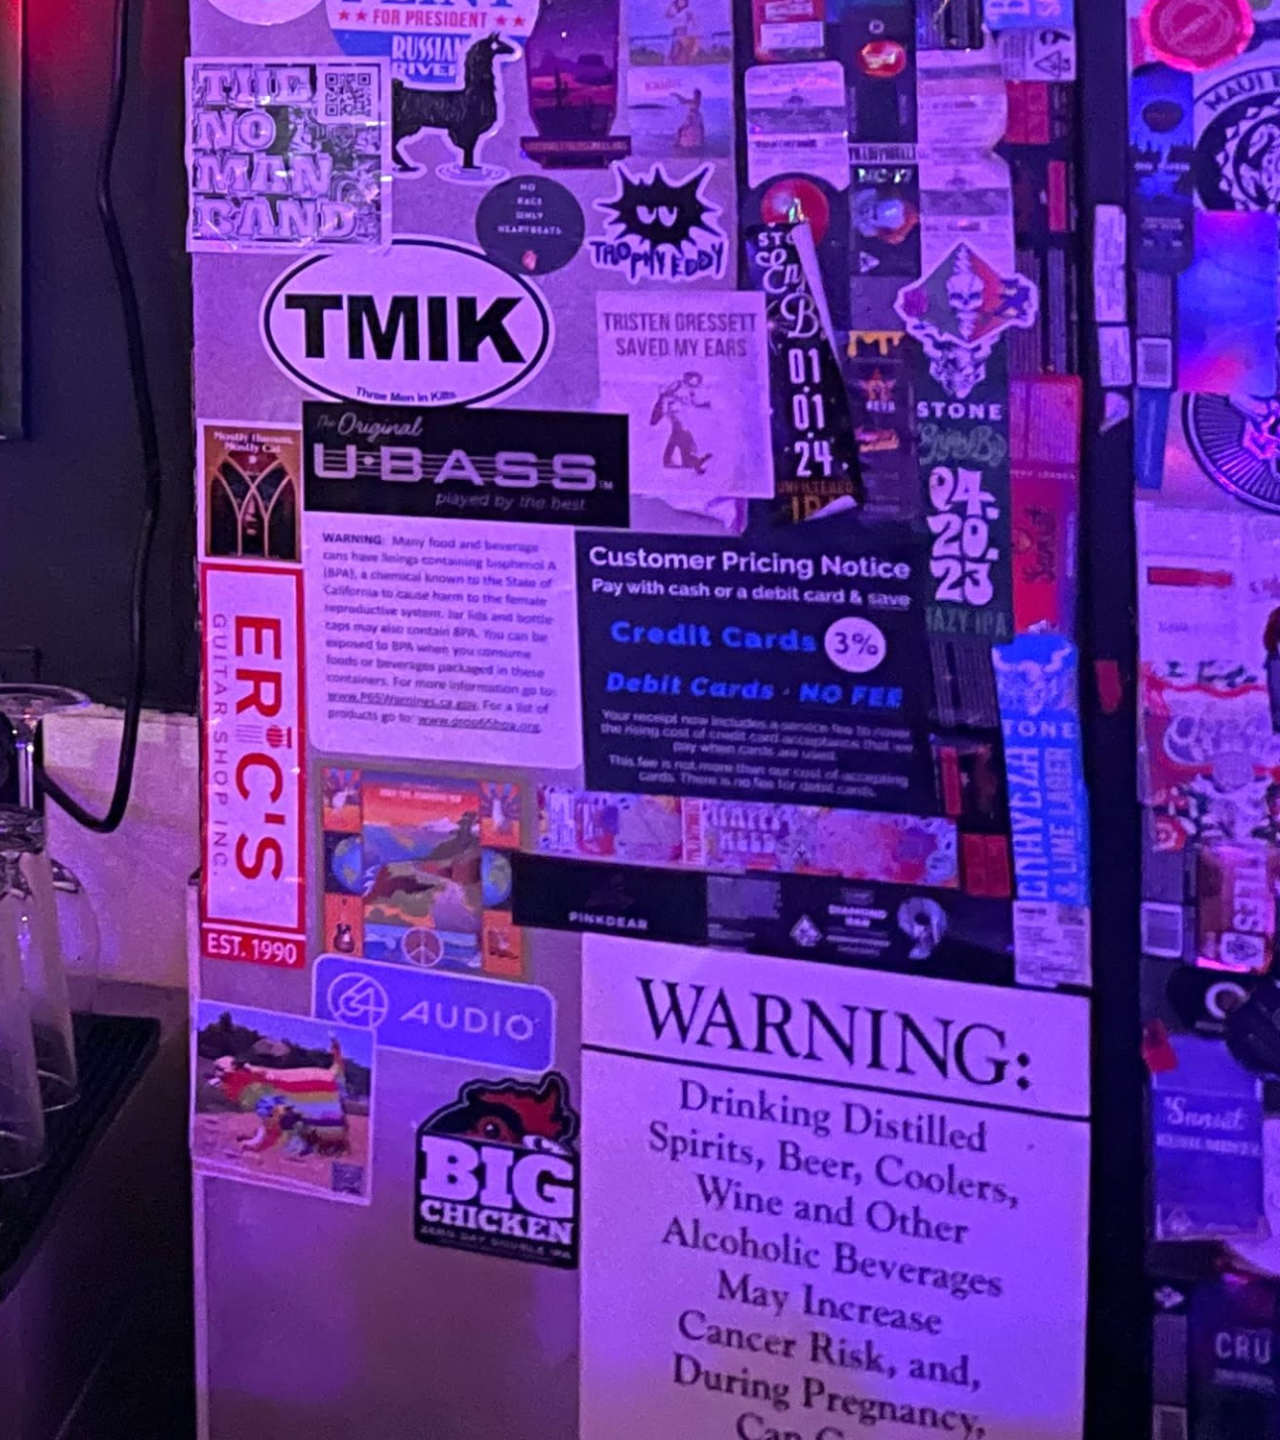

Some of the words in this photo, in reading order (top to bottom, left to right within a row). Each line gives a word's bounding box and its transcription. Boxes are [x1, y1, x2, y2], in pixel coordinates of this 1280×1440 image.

[372, 9, 402, 26] FOR
[405, 9, 487, 29] PRESIDENT
[392, 35, 467, 60] RUSSIAN
[193, 67, 313, 107] THE
[1203, 71, 1268, 111] MAUI
[193, 110, 276, 152] NO
[193, 152, 333, 195] MAN
[519, 184, 537, 192] NO
[193, 196, 358, 240] BAND
[590, 241, 666, 280] TROPHY
[671, 242, 725, 278] EDDY
[284, 293, 527, 365] TMIK
[603, 312, 671, 334] TRISTEN
[674, 311, 757, 334] DRESSETT
[615, 335, 671, 357] SAVED
[675, 336, 703, 358] MY
[706, 336, 748, 358] EARS
[355, 386, 384, 400] Three
[385, 390, 413, 402] Men
[416, 391, 427, 402] in
[916, 400, 1004, 421] STONE
[794, 439, 834, 478] 24
[434, 491, 491, 513] played
[494, 494, 514, 511] by
[518, 493, 546, 510] the
[550, 496, 587, 513] best
[391, 536, 425, 550] Many
[428, 536, 456, 550] food
[459, 539, 481, 550] and
[484, 540, 539, 554] beverage
[589, 546, 716, 572] Customer
[722, 550, 814, 580] Pricing
[821, 554, 911, 580] Notice
[591, 578, 624, 597] Pay
[627, 580, 664, 596] with
[667, 583, 711, 598] cash
[714, 586, 733, 599] or
[737, 587, 748, 600] a
[751, 585, 800, 602] debit
[803, 588, 845, 604] card
[849, 590, 863, 605] &
[868, 593, 912, 608] save
[928, 558, 994, 606] 23
[610, 619, 713, 648] Credit
[721, 626, 818, 652] Cards
[833, 631, 879, 656] 3%
[211, 613, 230, 720] GUITAR
[605, 671, 683, 696] Debit
[689, 676, 775, 701] Cards
[799, 682, 843, 704] NO
[850, 684, 904, 709] FEE
[213, 726, 230, 810] SHOP
[213, 820, 231, 877] INC.
[206, 932, 248, 958] EST.
[251, 937, 298, 964] 1990
[635, 974, 1032, 1093] WARNING:
[679, 1077, 832, 1138] Drinking
[842, 1102, 989, 1154] Distilled
[419, 1135, 575, 1219] BIG
[648, 1120, 766, 1174] Spirits,
[778, 1139, 864, 1187] Beer,
[875, 1154, 1020, 1212] Coolers,
[420, 1199, 575, 1246] CHICKEN
[695, 1172, 784, 1219] Wine
[793, 1194, 855, 1230] and
[865, 1200, 970, 1246] Other
[661, 1215, 821, 1272] Alcoholic
[832, 1241, 1004, 1302] Beverages
[716, 1268, 791, 1318] May
[802, 1284, 943, 1337] Increase
[676, 1309, 797, 1361] Cancer
[809, 1330, 898, 1380] Risk,
[908, 1355, 982, 1392] and,
[672, 1352, 791, 1412] During
[802, 1376, 987, 1439] Pregnancy,
[736, 1411, 817, 1440] Can
